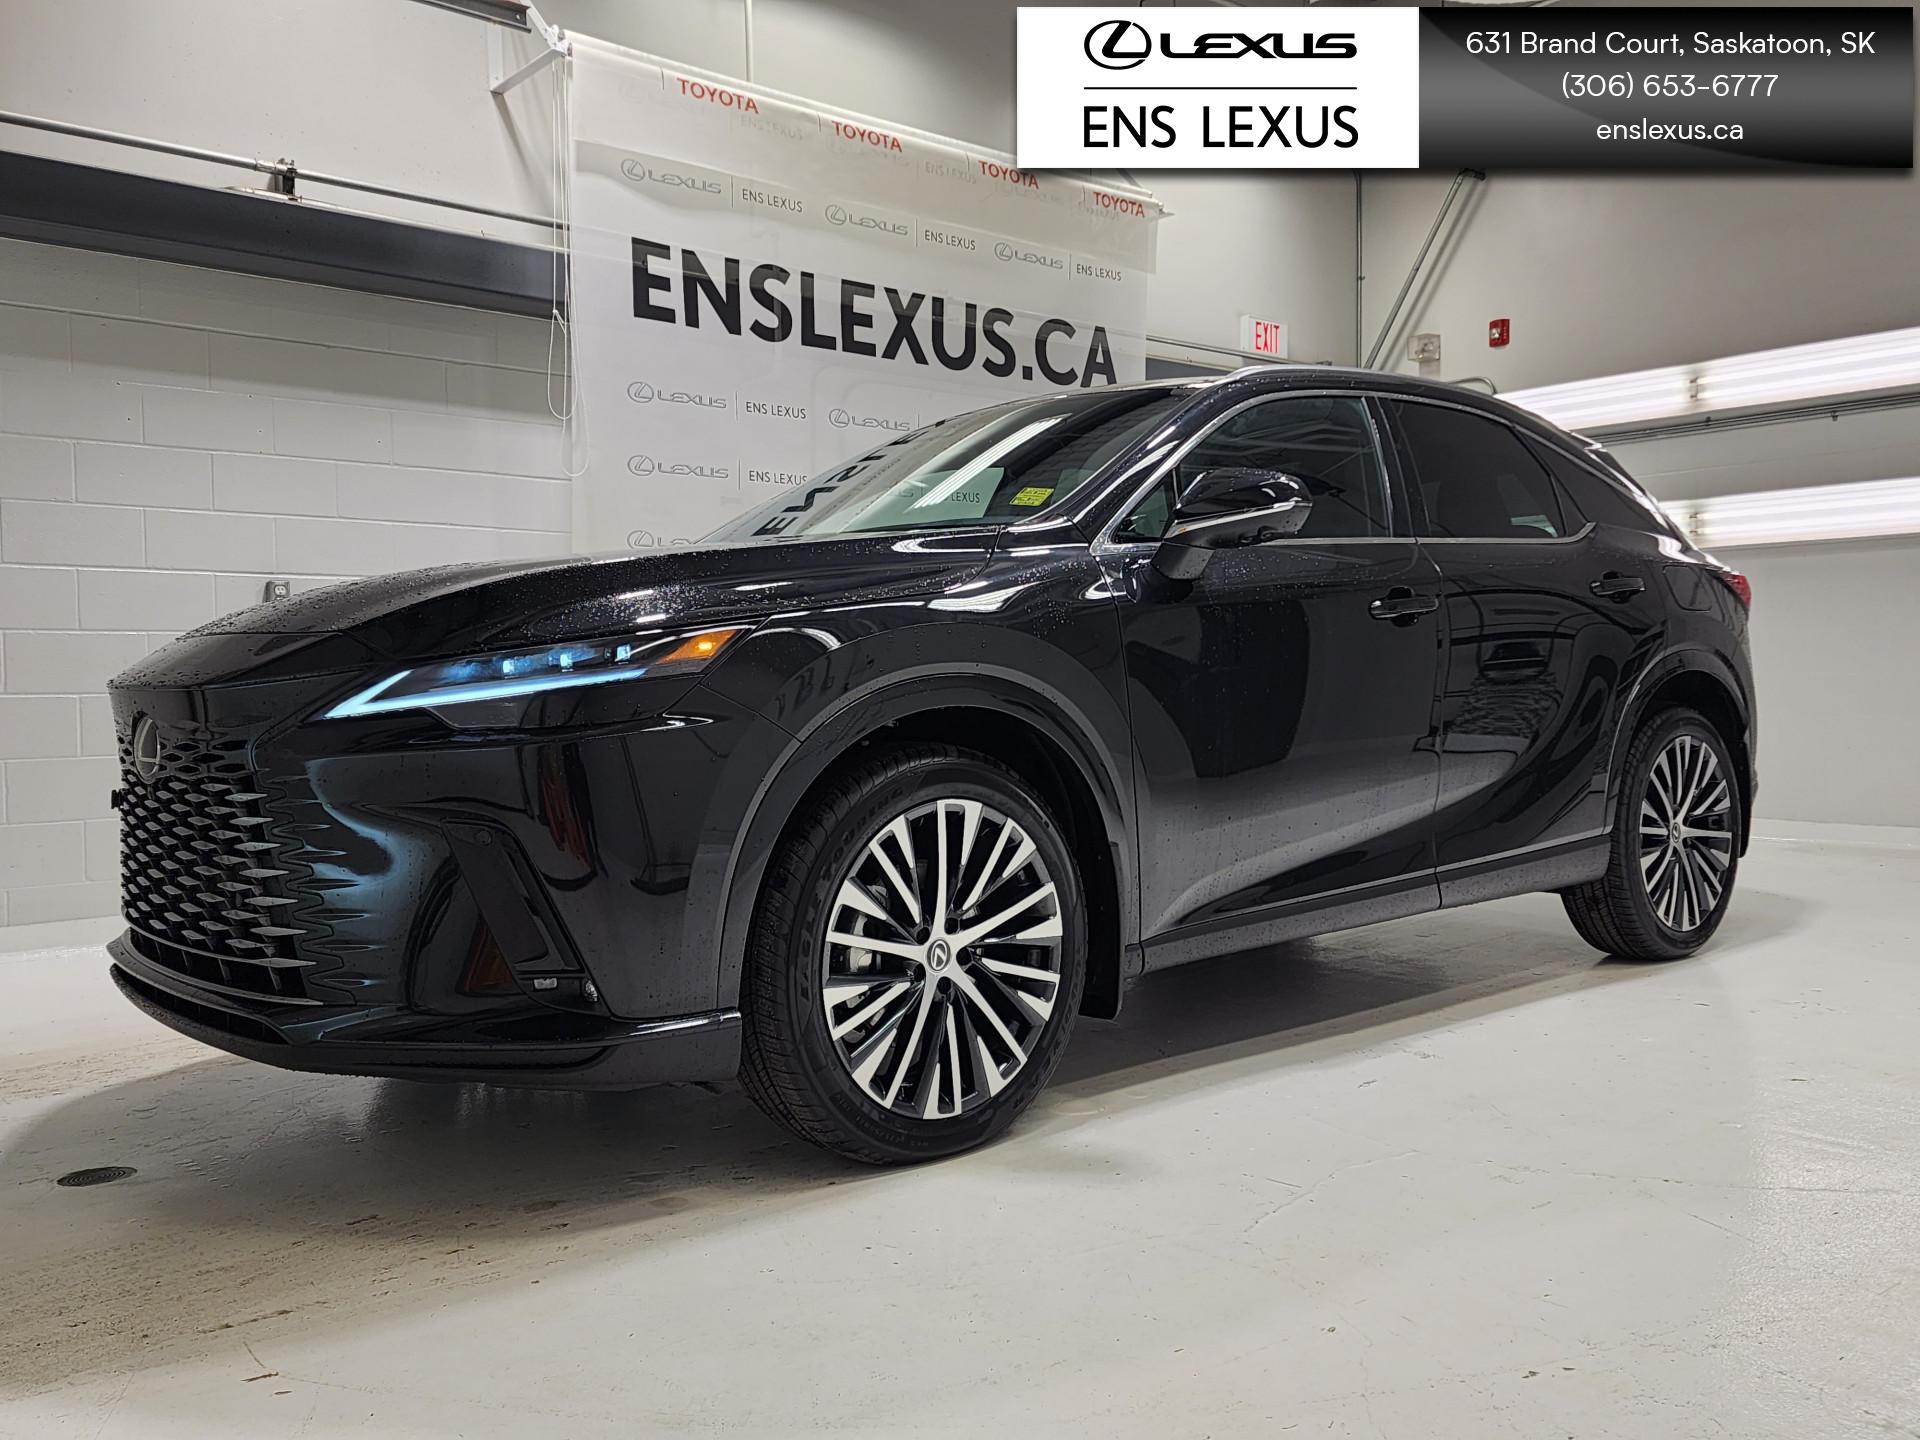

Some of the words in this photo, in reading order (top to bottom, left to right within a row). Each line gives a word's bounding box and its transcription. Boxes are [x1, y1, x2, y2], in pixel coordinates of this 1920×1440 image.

[677, 77, 759, 114] TOYOTA
[832, 120, 902, 153] TOYOTA
[648, 168, 722, 195] LEXUS
[742, 188, 764, 204] ENS
[767, 193, 803, 213] LEXUS
[978, 160, 1039, 190] TOYOTA
[1093, 192, 1145, 218] TOYOTA
[849, 213, 908, 236] LEXUS
[925, 229, 944, 245] ENS
[945, 234, 976, 251] LEXUS
[1014, 249, 1064, 270] LEXUS
[1076, 263, 1093, 277] ENS
[1094, 266, 1122, 282] LEXUS
[631, 236, 1118, 388] ENSLEXUS.CA
[1255, 320, 1280, 354] EXIT
[657, 389, 727, 409] LEXUS
[746, 401, 768, 415] ENS
[771, 405, 807, 420] LEXUS
[851, 415, 911, 432] LEXUS
[657, 461, 729, 479] LEXUS
[749, 470, 771, 483] ENS
[951, 491, 980, 504] LEXUS
